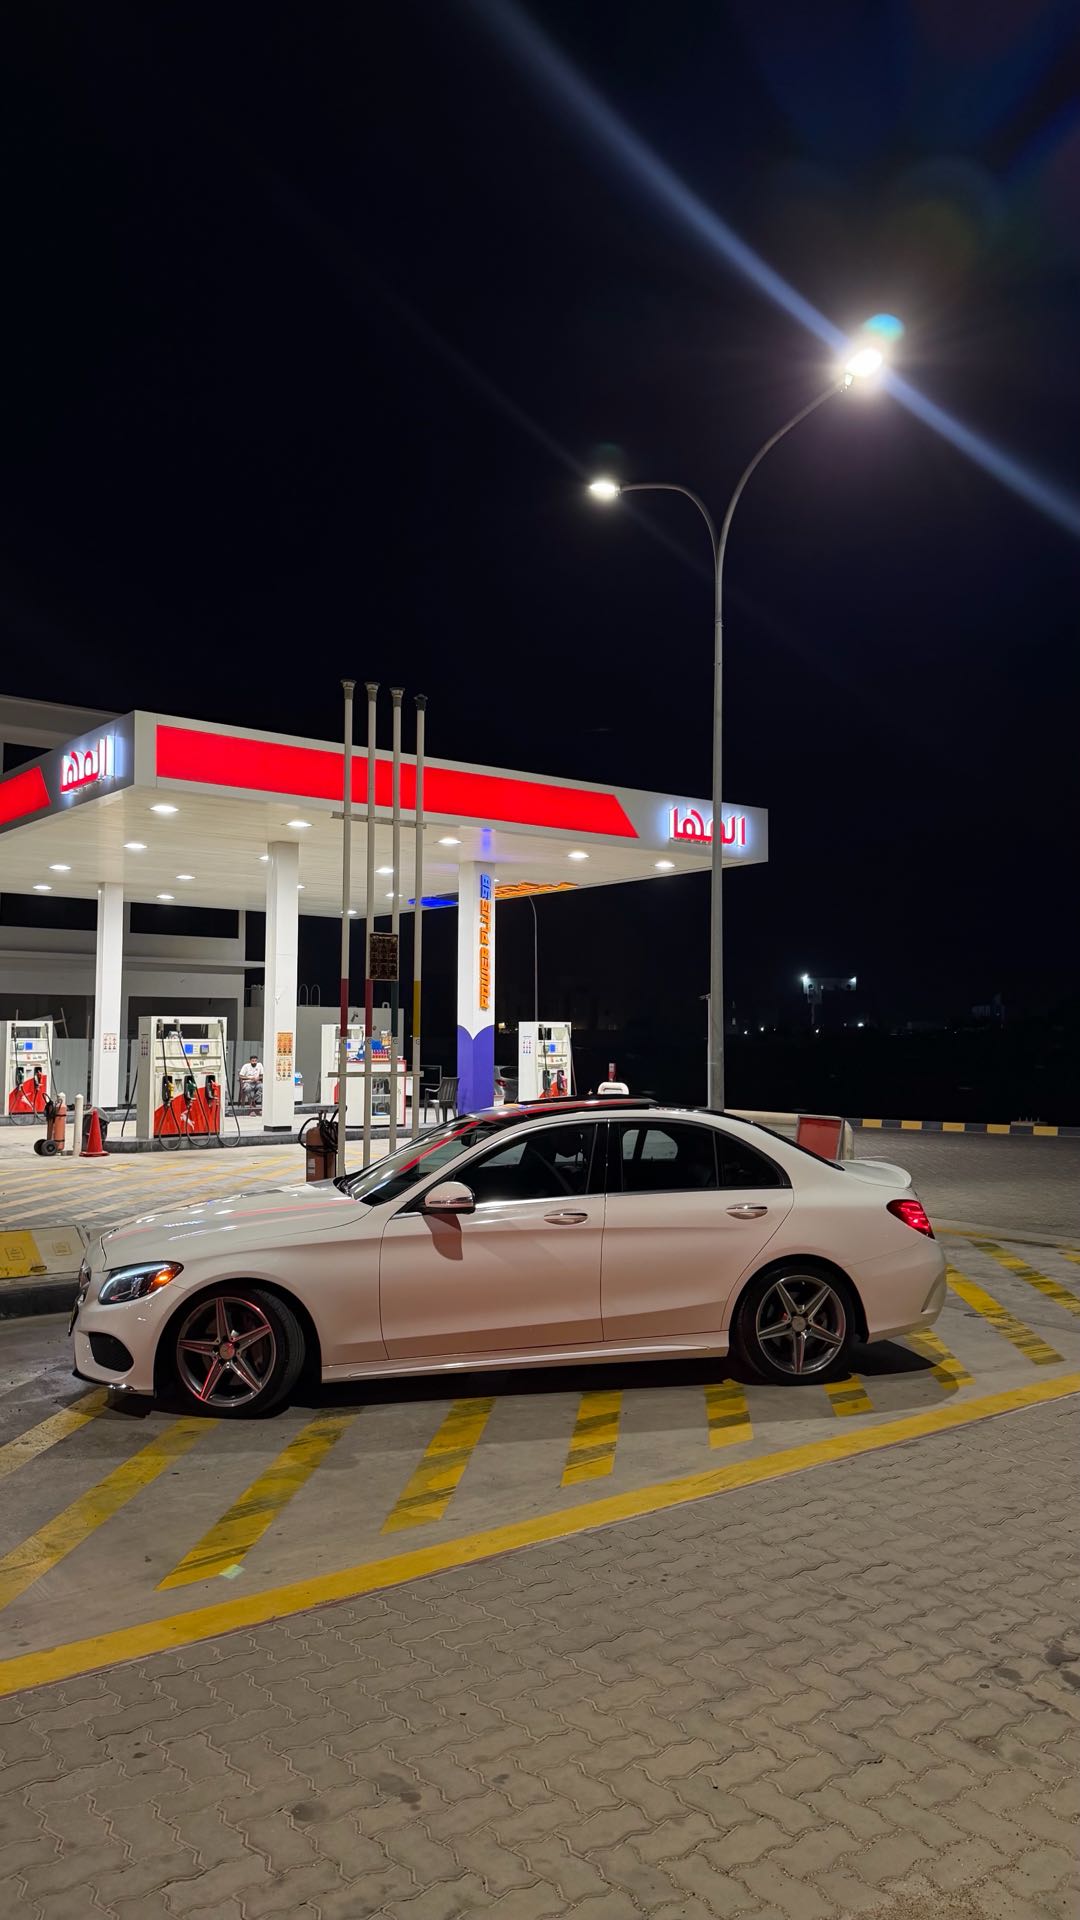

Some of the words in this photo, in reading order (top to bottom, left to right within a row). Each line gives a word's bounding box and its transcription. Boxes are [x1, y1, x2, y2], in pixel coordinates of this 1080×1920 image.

[60, 735, 115, 794] المها
[479, 900, 492, 946] PLUS
[479, 947, 491, 1011] POWER
